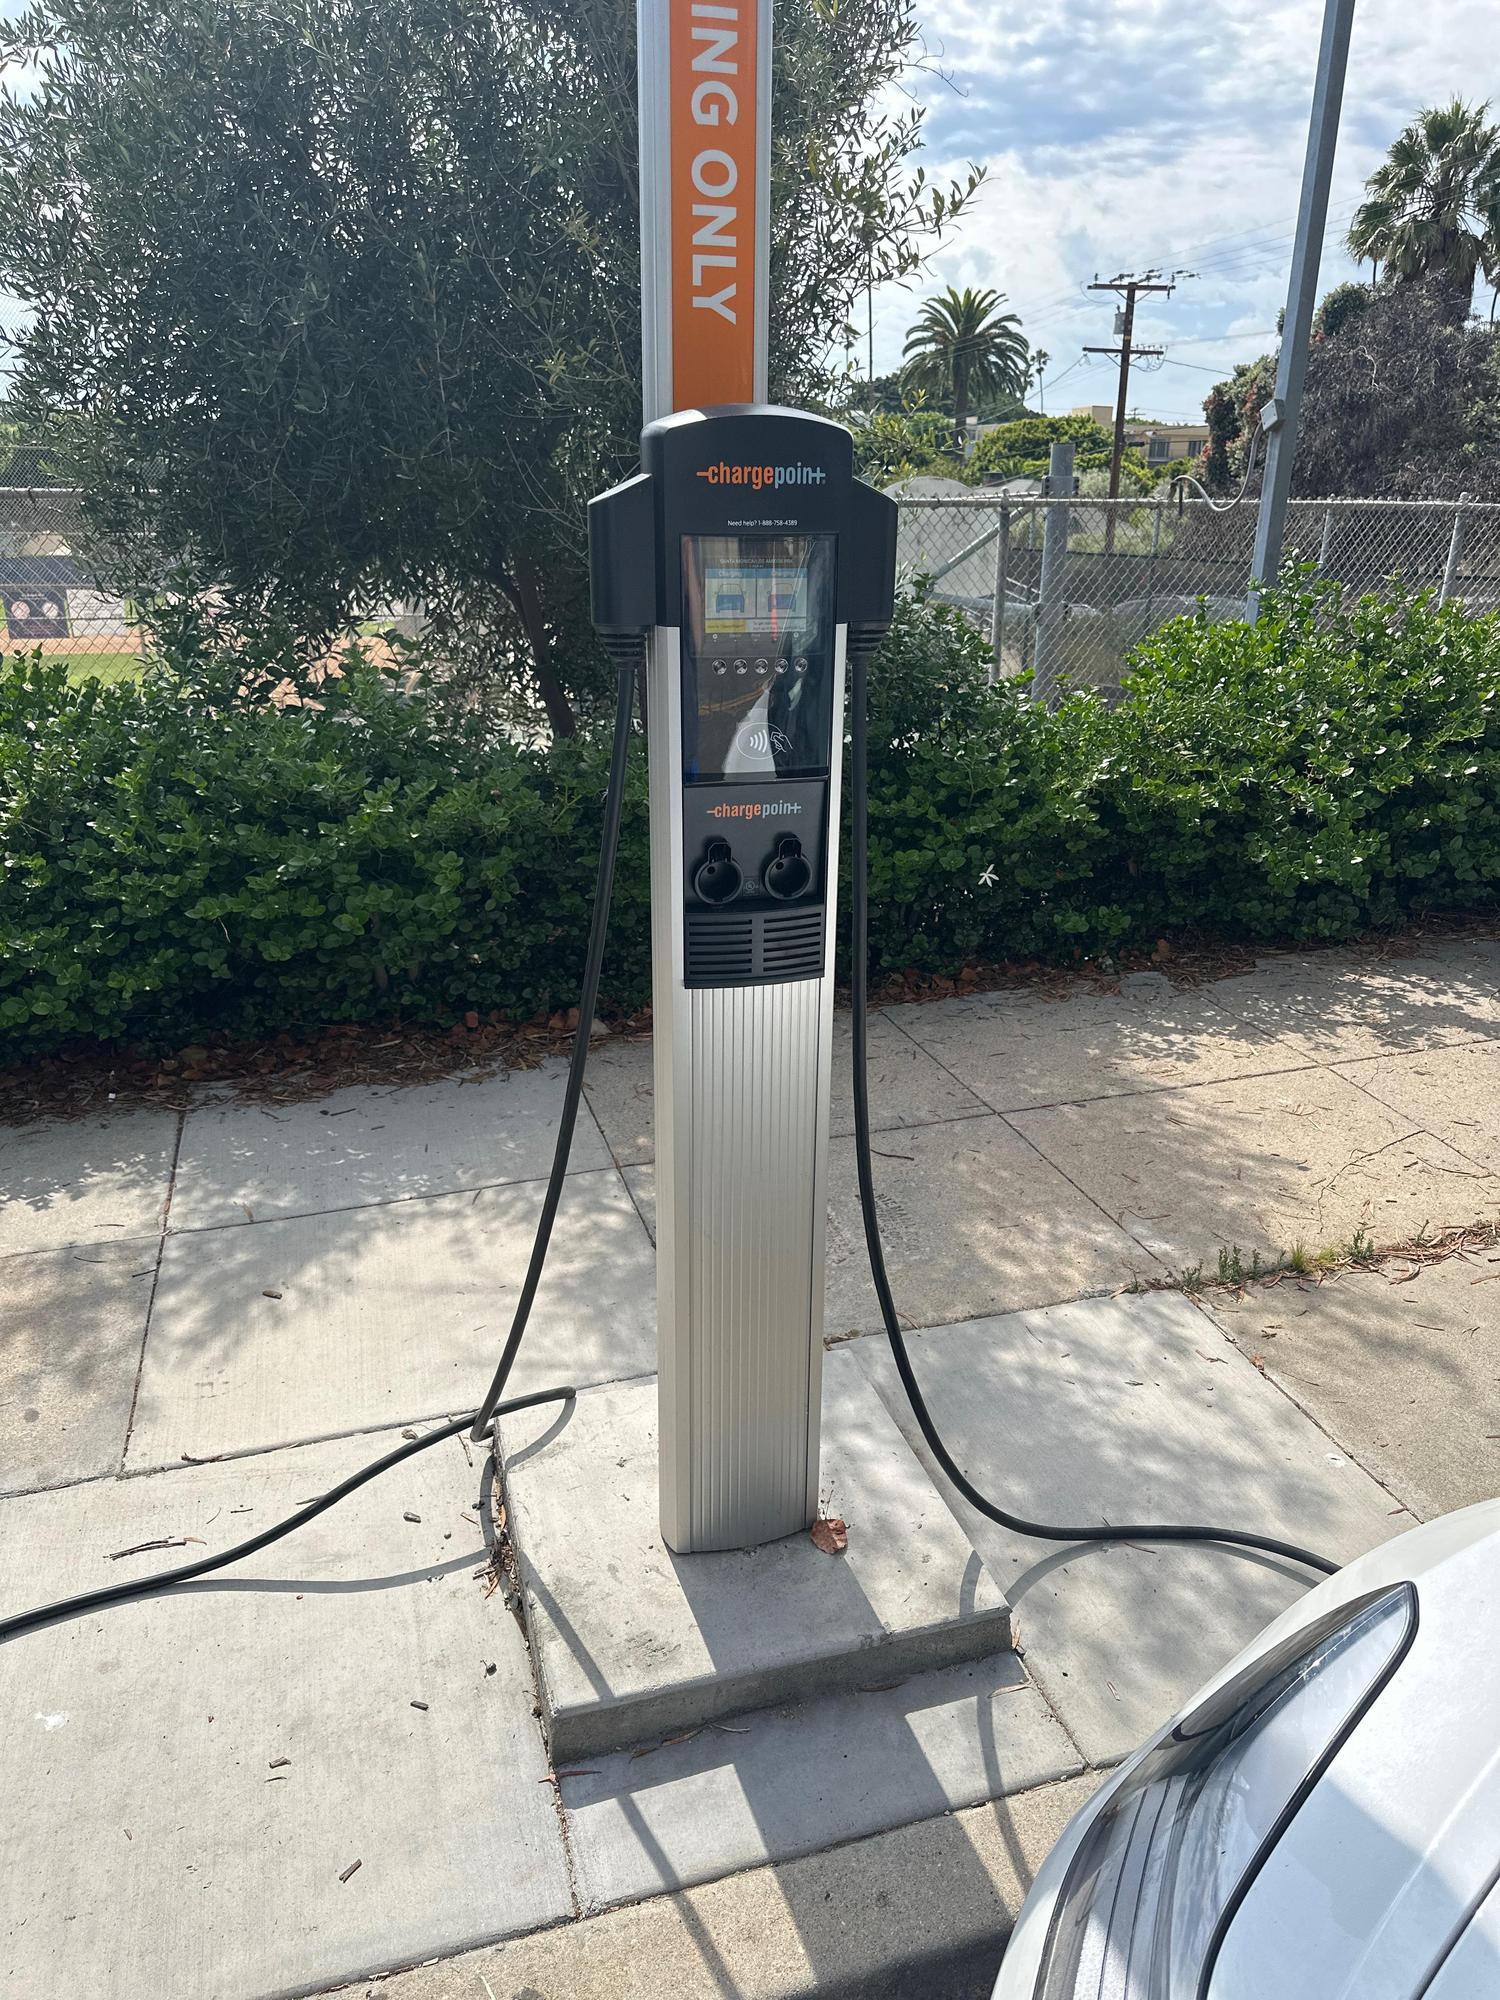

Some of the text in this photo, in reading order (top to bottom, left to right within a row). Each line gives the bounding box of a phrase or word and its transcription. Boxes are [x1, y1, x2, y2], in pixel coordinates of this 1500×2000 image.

[691, 4, 738, 325] ING ONLY
[697, 461, 826, 490] chargepoint
[743, 519, 757, 527] help?
[706, 800, 802, 819] chargepoint
